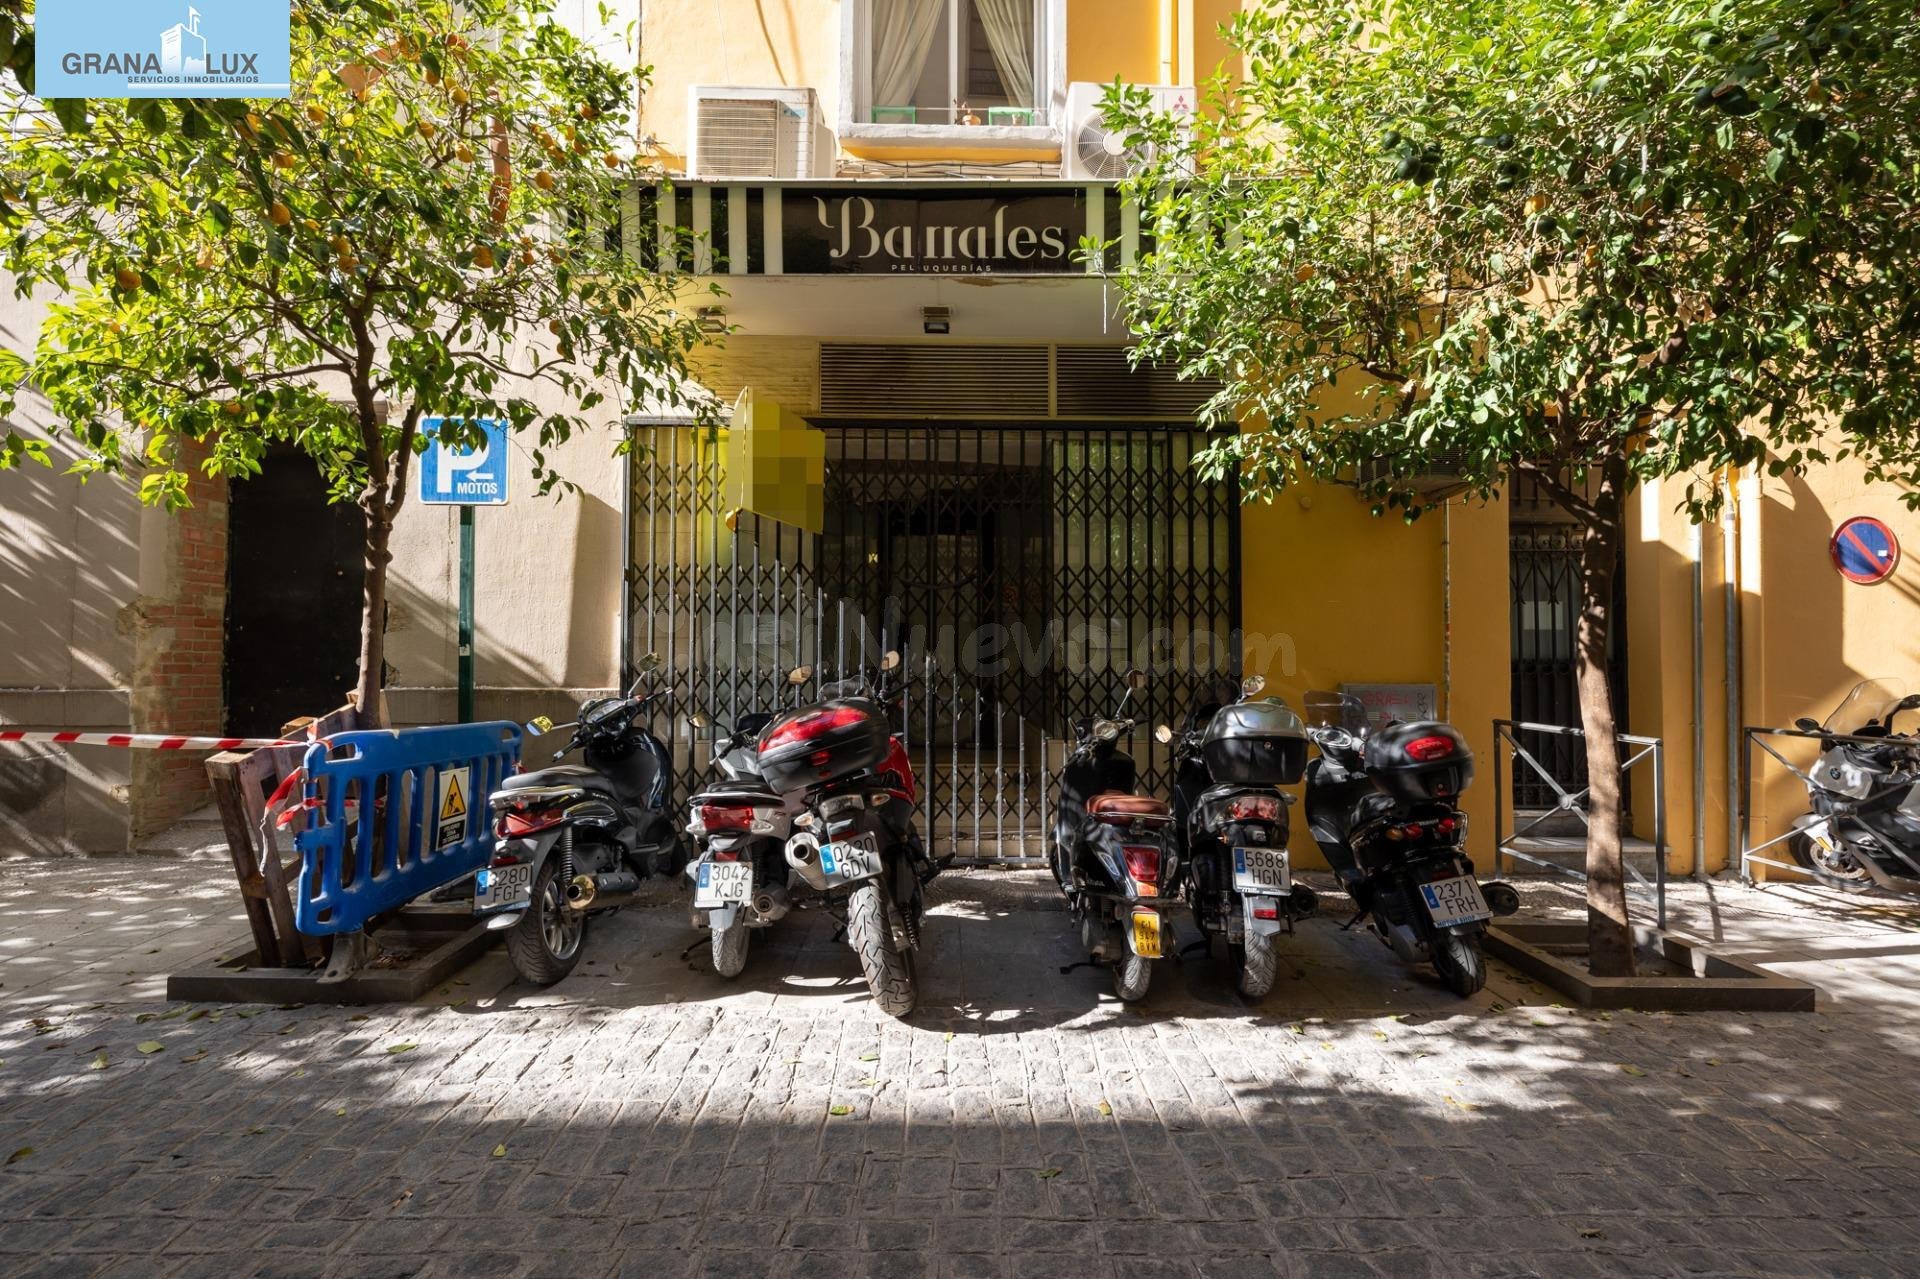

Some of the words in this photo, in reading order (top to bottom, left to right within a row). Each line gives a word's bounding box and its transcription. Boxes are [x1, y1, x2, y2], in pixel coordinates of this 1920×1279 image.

[812, 196, 1065, 259] Barrales
[891, 264, 991, 272] PELUQUERÍAS
[457, 482, 498, 494] MOTOS
[841, 855, 870, 879] GDV
[1245, 851, 1285, 869] 5688
[711, 865, 750, 881] 3042
[1252, 868, 1282, 886] HGN
[493, 883, 522, 902] FGF
[714, 882, 743, 898] KJG
[1434, 880, 1474, 900] 2371
[1445, 895, 1480, 916] FRH
